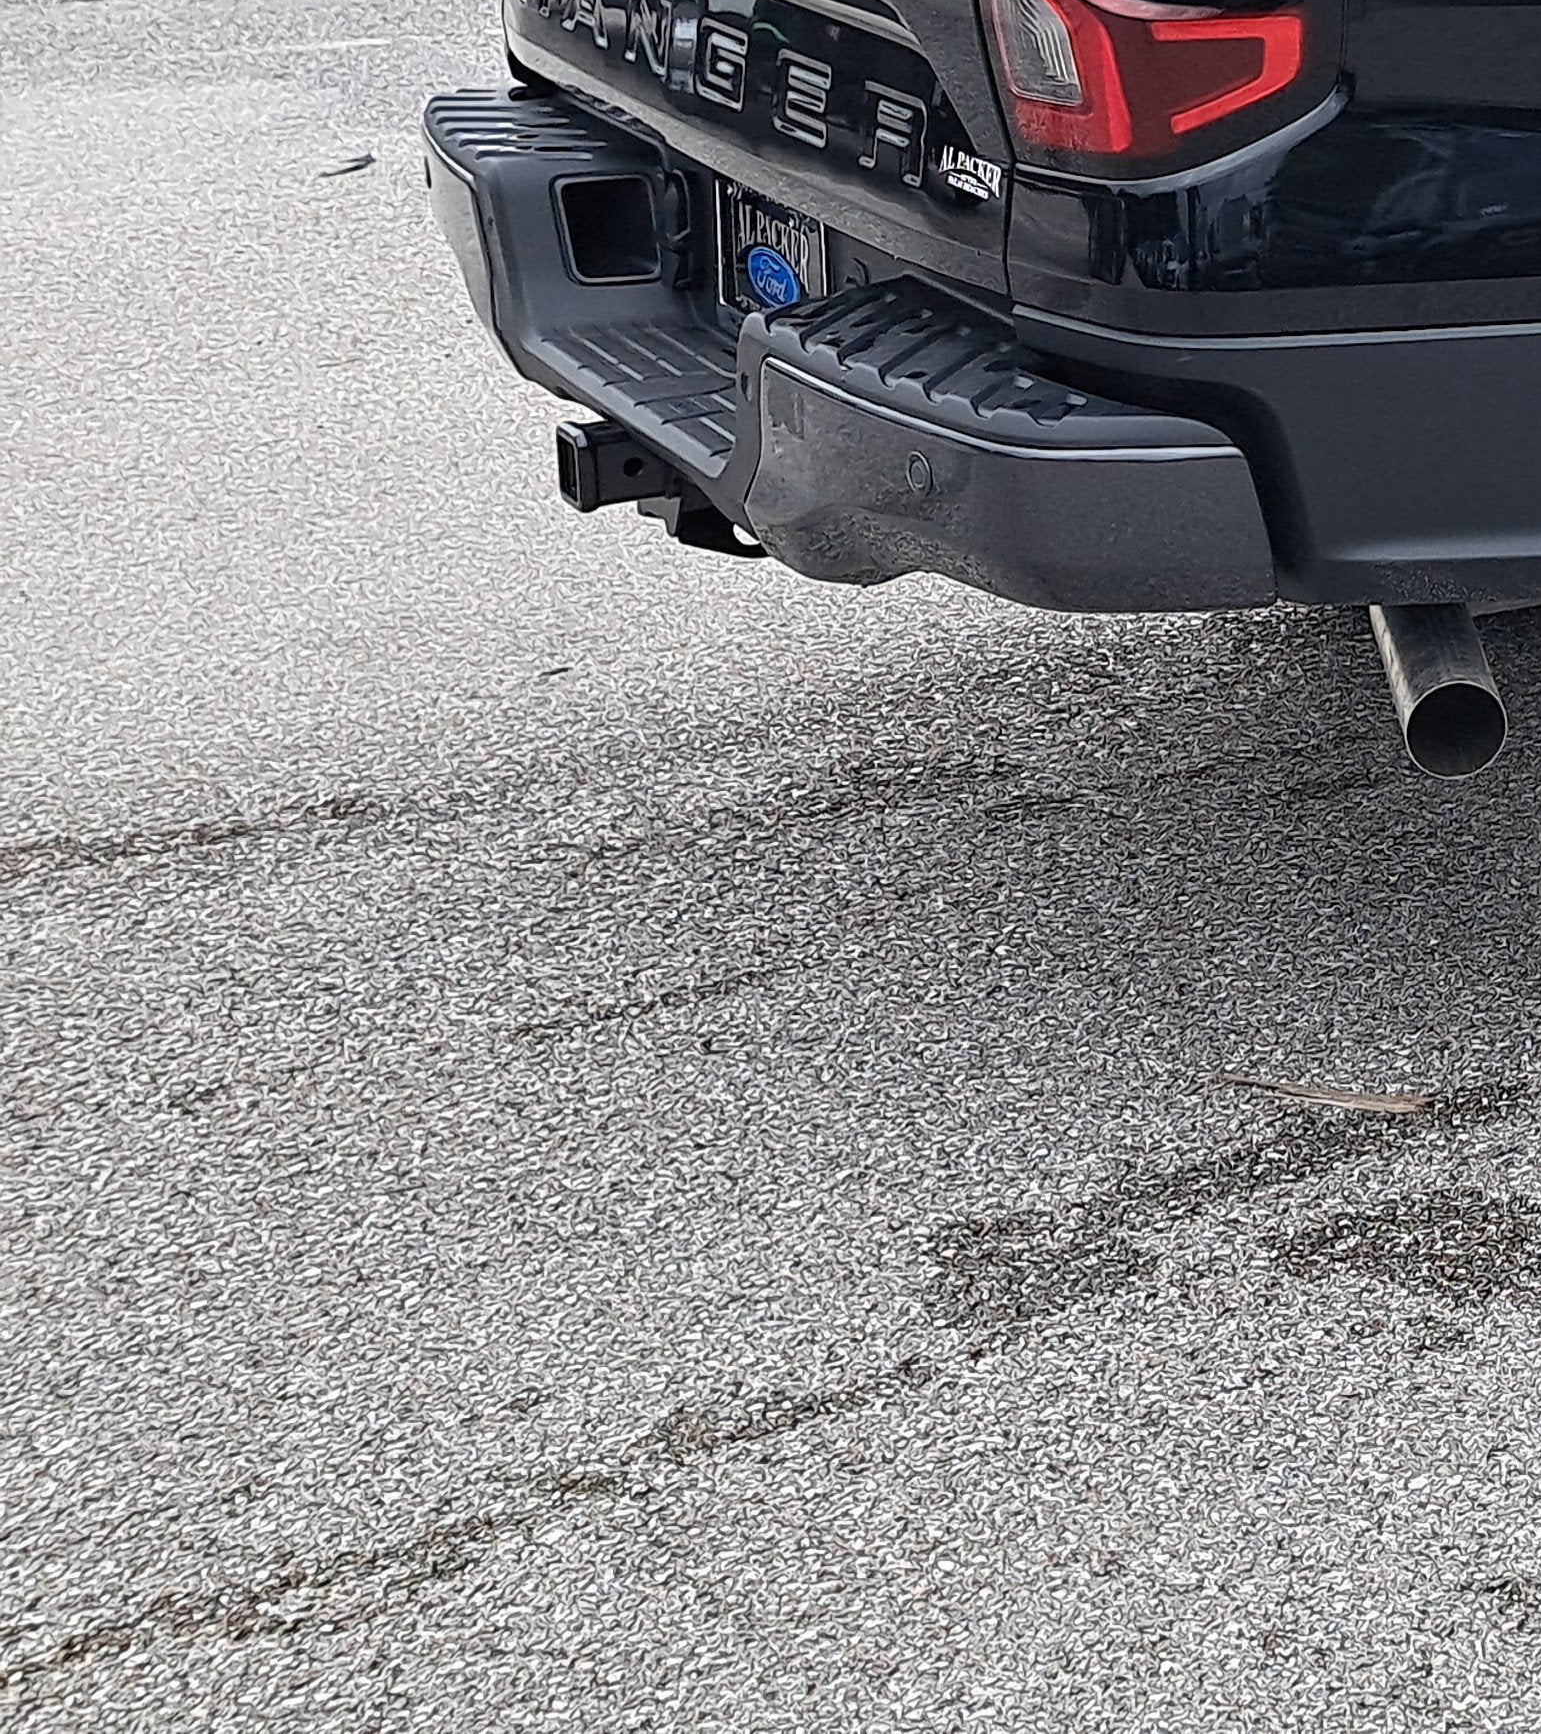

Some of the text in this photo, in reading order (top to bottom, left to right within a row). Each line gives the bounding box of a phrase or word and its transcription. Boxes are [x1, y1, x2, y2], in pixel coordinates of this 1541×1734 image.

[938, 144, 955, 174] AL
[956, 151, 1002, 199] PACKER
[737, 200, 810, 296] AL PACKER
[756, 255, 788, 303] Ford
